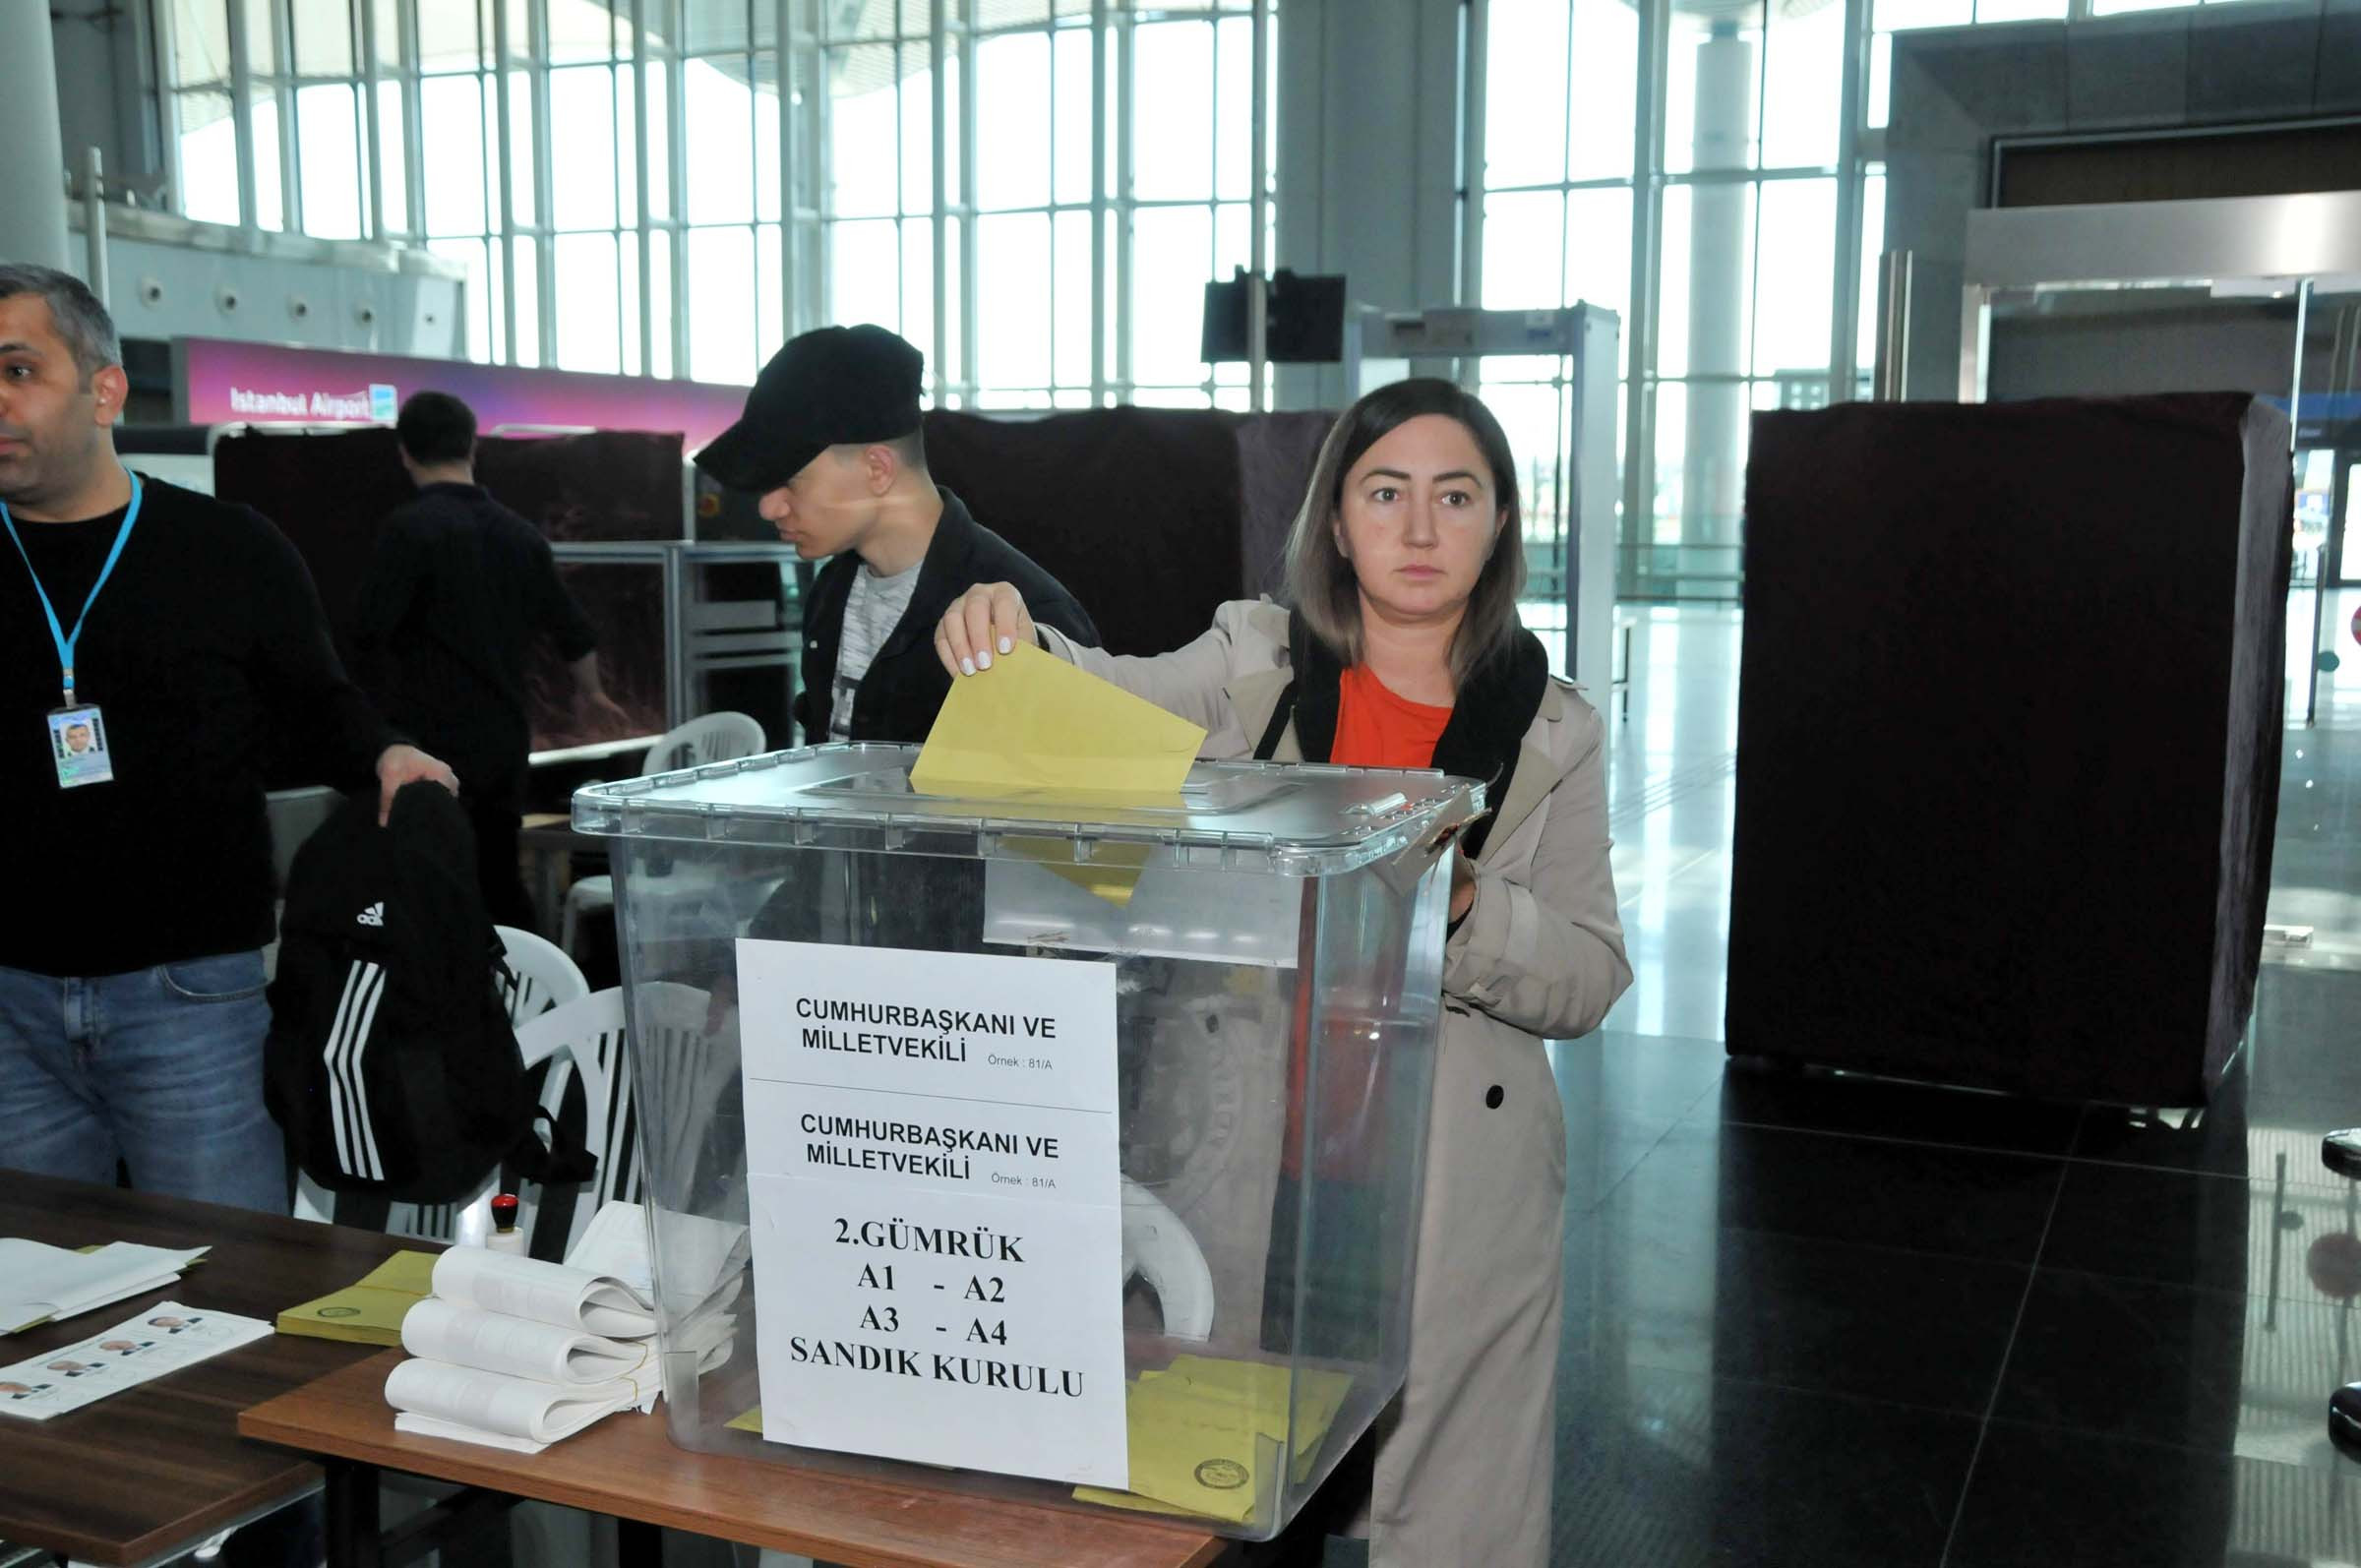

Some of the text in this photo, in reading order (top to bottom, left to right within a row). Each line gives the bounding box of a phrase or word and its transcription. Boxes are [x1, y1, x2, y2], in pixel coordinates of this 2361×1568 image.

[795, 997, 1057, 1039] CUMHURBAŞKANI VE
[802, 1025, 967, 1062] MİLLETVEKİLİ
[1028, 1057, 1053, 1070] 81/A
[800, 1114, 1059, 1159] CUMHURBAŞKANI VE
[807, 1140, 970, 1180] MİLLETVEKİLİ
[1032, 1176, 1057, 1189] 81/A
[834, 1217, 1026, 1263] 2.GÜMRÜK
[857, 1262, 896, 1292] A1
[964, 1274, 1005, 1303] A2
[859, 1304, 899, 1333] A3
[966, 1317, 1007, 1346] A4
[790, 1336, 1086, 1398] SANDIK KURULU
